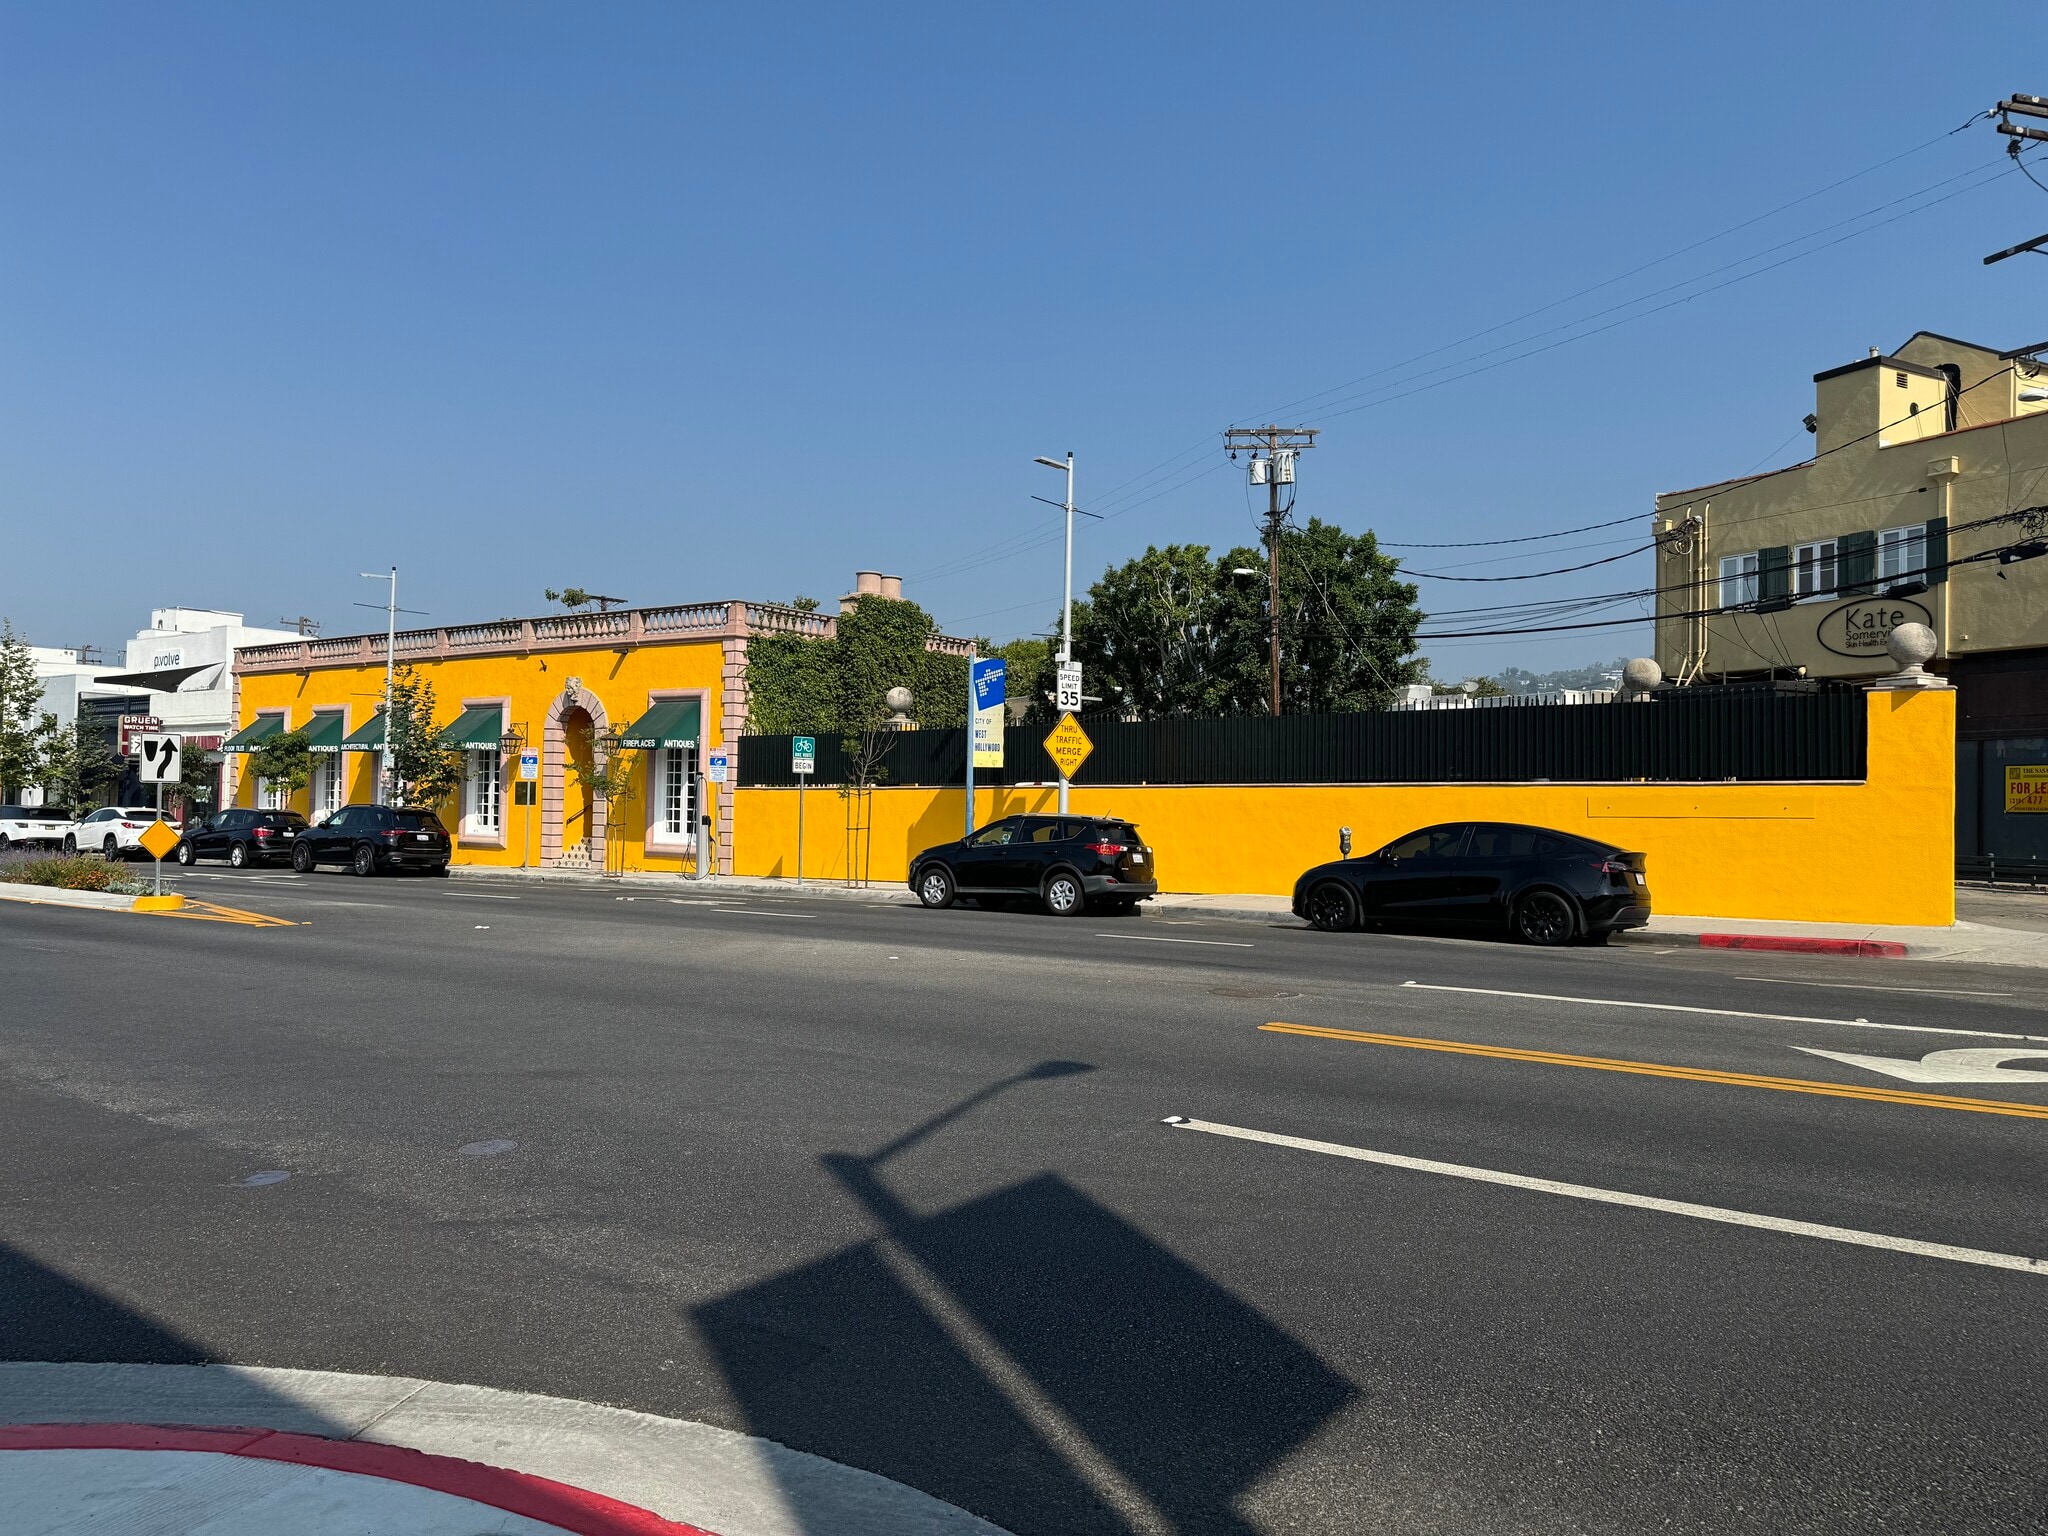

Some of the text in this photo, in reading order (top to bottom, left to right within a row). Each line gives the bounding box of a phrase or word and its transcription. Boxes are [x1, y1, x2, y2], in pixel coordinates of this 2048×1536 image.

[1846, 607, 1905, 630] Kate
[1845, 627, 1895, 641] Somervi
[1858, 639, 1879, 647] Health
[154, 653, 180, 670] p.volve
[1059, 674, 1080, 682] SPEED
[1061, 682, 1078, 690] LIMIT
[1060, 691, 1079, 706] 35
[124, 716, 158, 725] GRUEN
[1061, 725, 1078, 733] THRU
[975, 730, 987, 738] WEST
[622, 738, 656, 748] FIREPLACES
[663, 739, 695, 748] ANTIQUES
[1056, 736, 1082, 745] TRAFFIC
[465, 742, 497, 750] ANTIQUES
[975, 743, 1001, 752] HOLLYWOOD
[1056, 747, 1082, 756] MERGE
[1060, 758, 1078, 766] RIGHT
[2010, 782, 2048, 795] FOR LE
